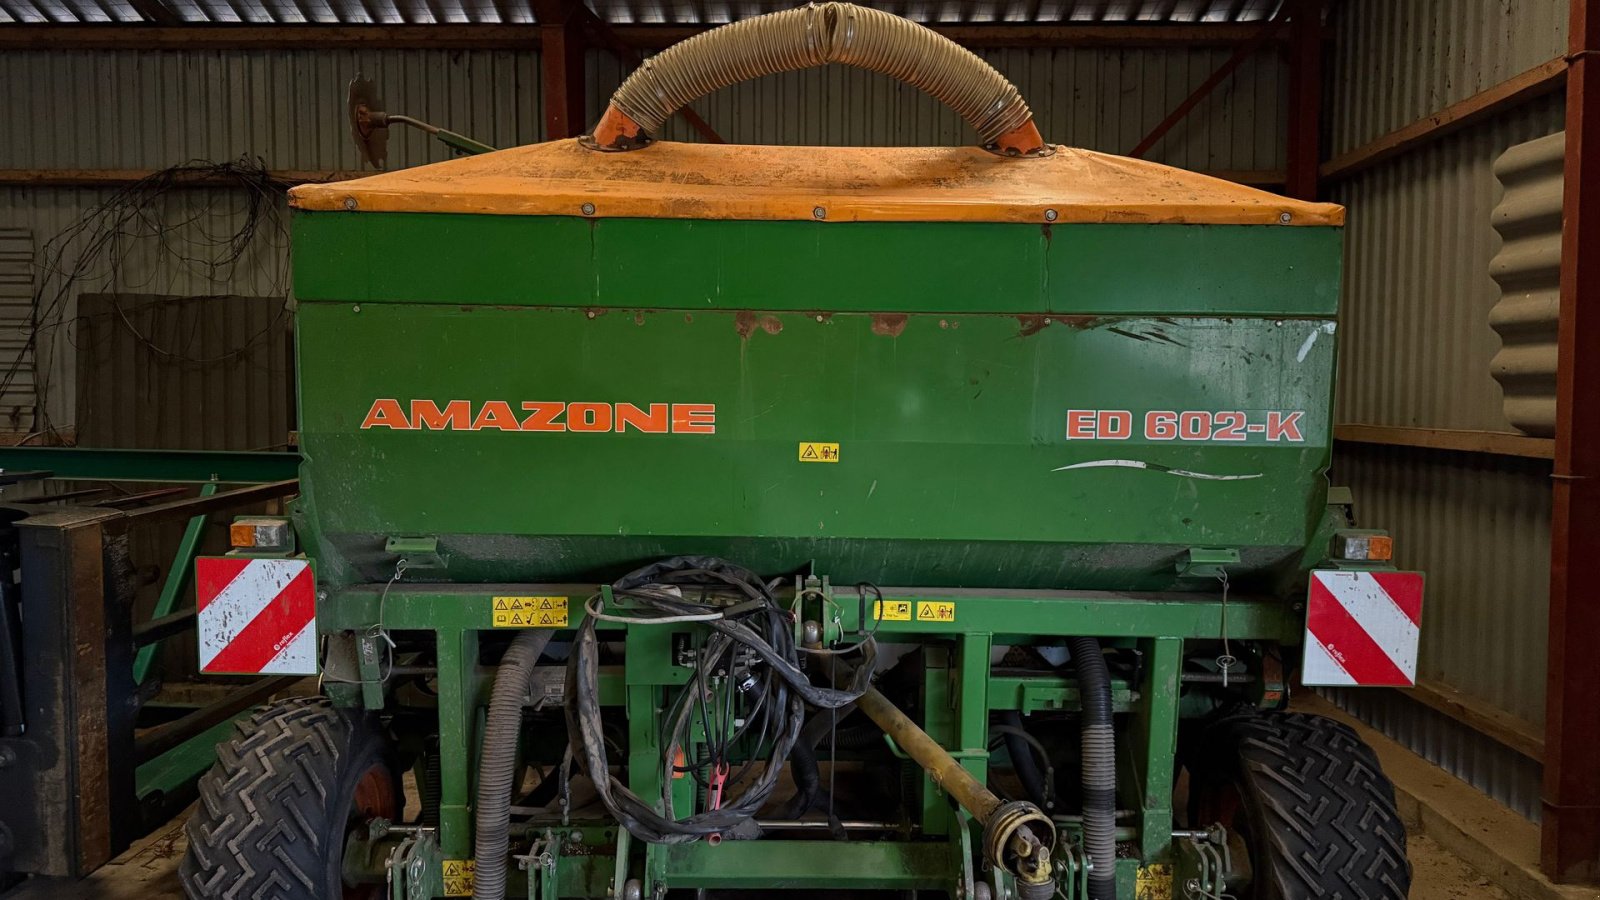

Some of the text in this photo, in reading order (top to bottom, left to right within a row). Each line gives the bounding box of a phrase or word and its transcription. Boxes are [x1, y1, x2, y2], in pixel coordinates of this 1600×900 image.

[360, 398, 716, 434] AMAZONE
[1066, 410, 1305, 441] ED 602-K
